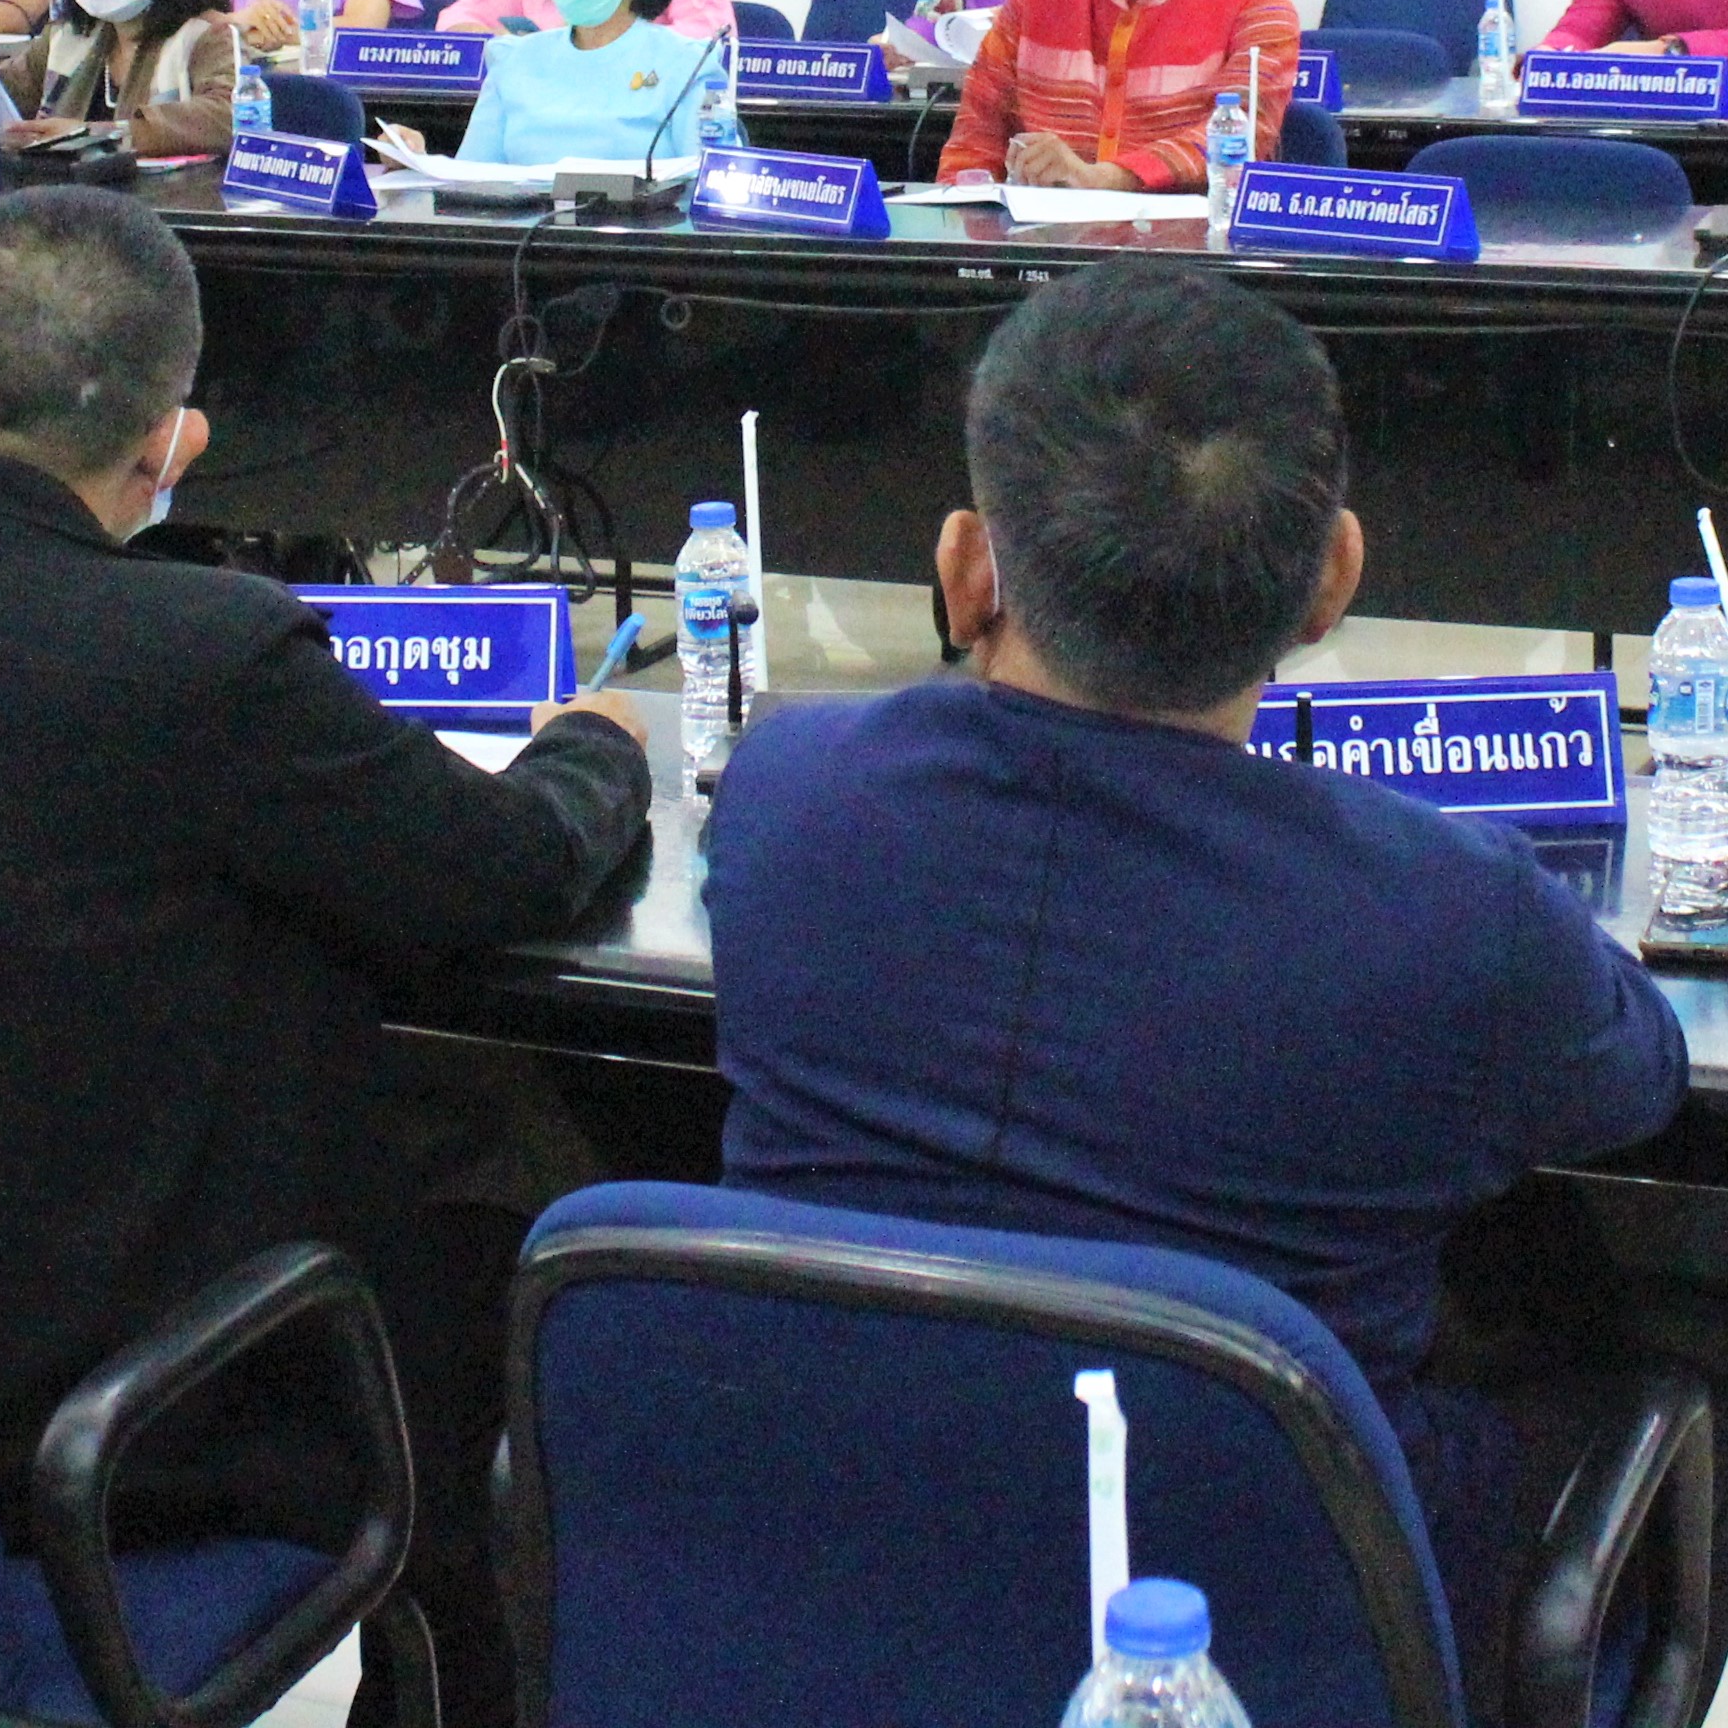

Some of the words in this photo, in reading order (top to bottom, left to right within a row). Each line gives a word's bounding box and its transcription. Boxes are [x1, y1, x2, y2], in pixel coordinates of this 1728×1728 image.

[358, 42, 461, 65] แรงงานจังหวัด
[776, 53, 857, 78] อบจ.ยโสธร
[1528, 66, 1719, 95] ผอ.ธ.ออมสินเขตยโสธร
[1289, 185, 1439, 226] ธ.ก.ส.จังหวัดยโสธร
